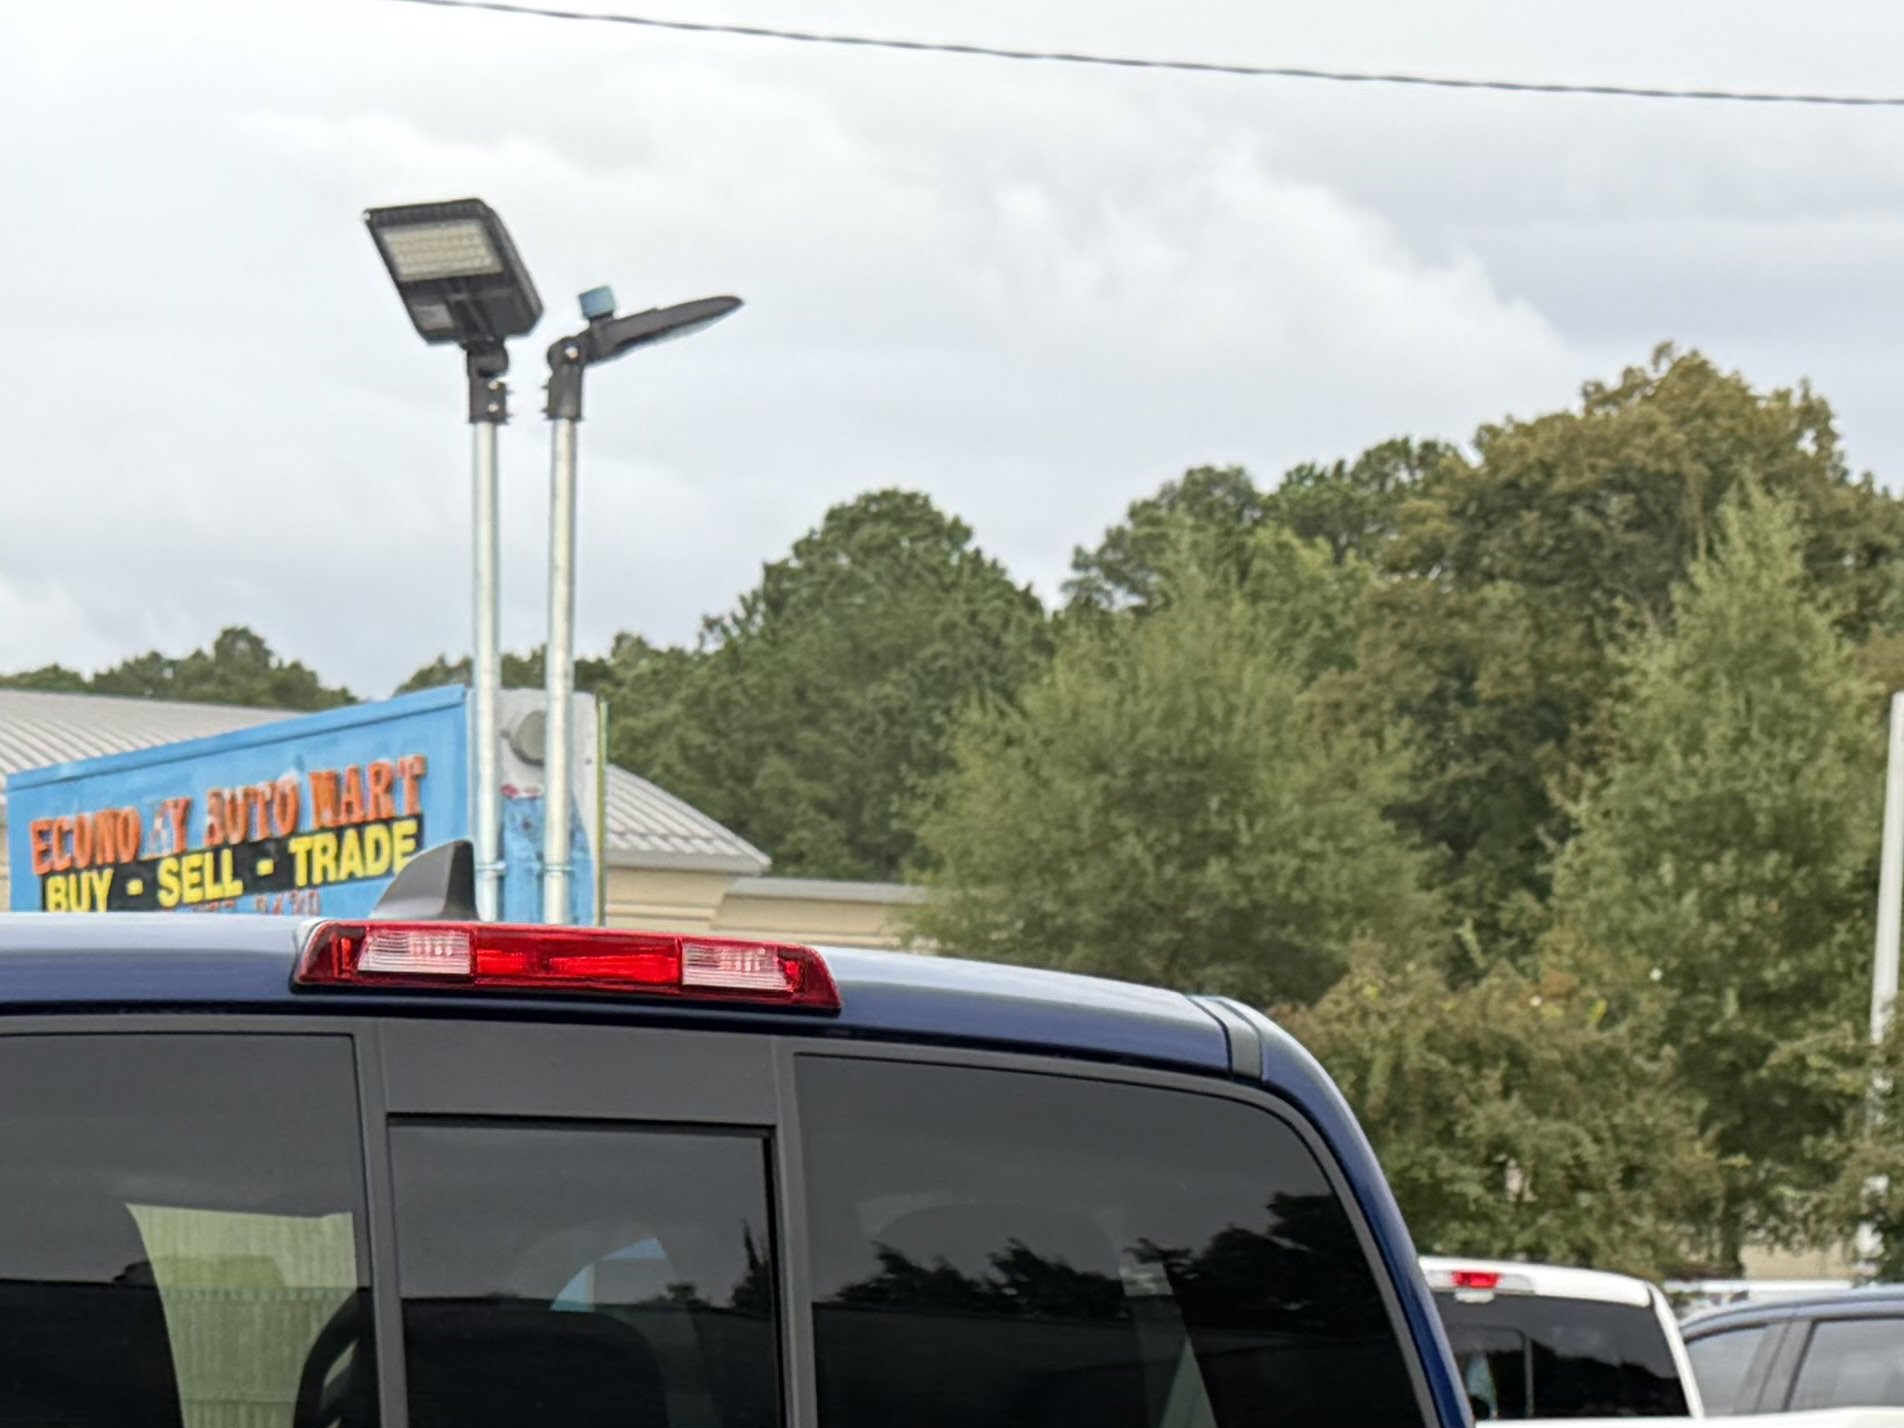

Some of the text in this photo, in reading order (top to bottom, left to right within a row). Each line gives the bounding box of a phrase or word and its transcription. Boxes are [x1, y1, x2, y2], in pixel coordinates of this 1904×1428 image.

[203, 773, 301, 849] AUTO
[308, 755, 427, 830] MART
[45, 869, 114, 912] BUY
[157, 847, 244, 907] SELL
[287, 819, 418, 888] TRADE
